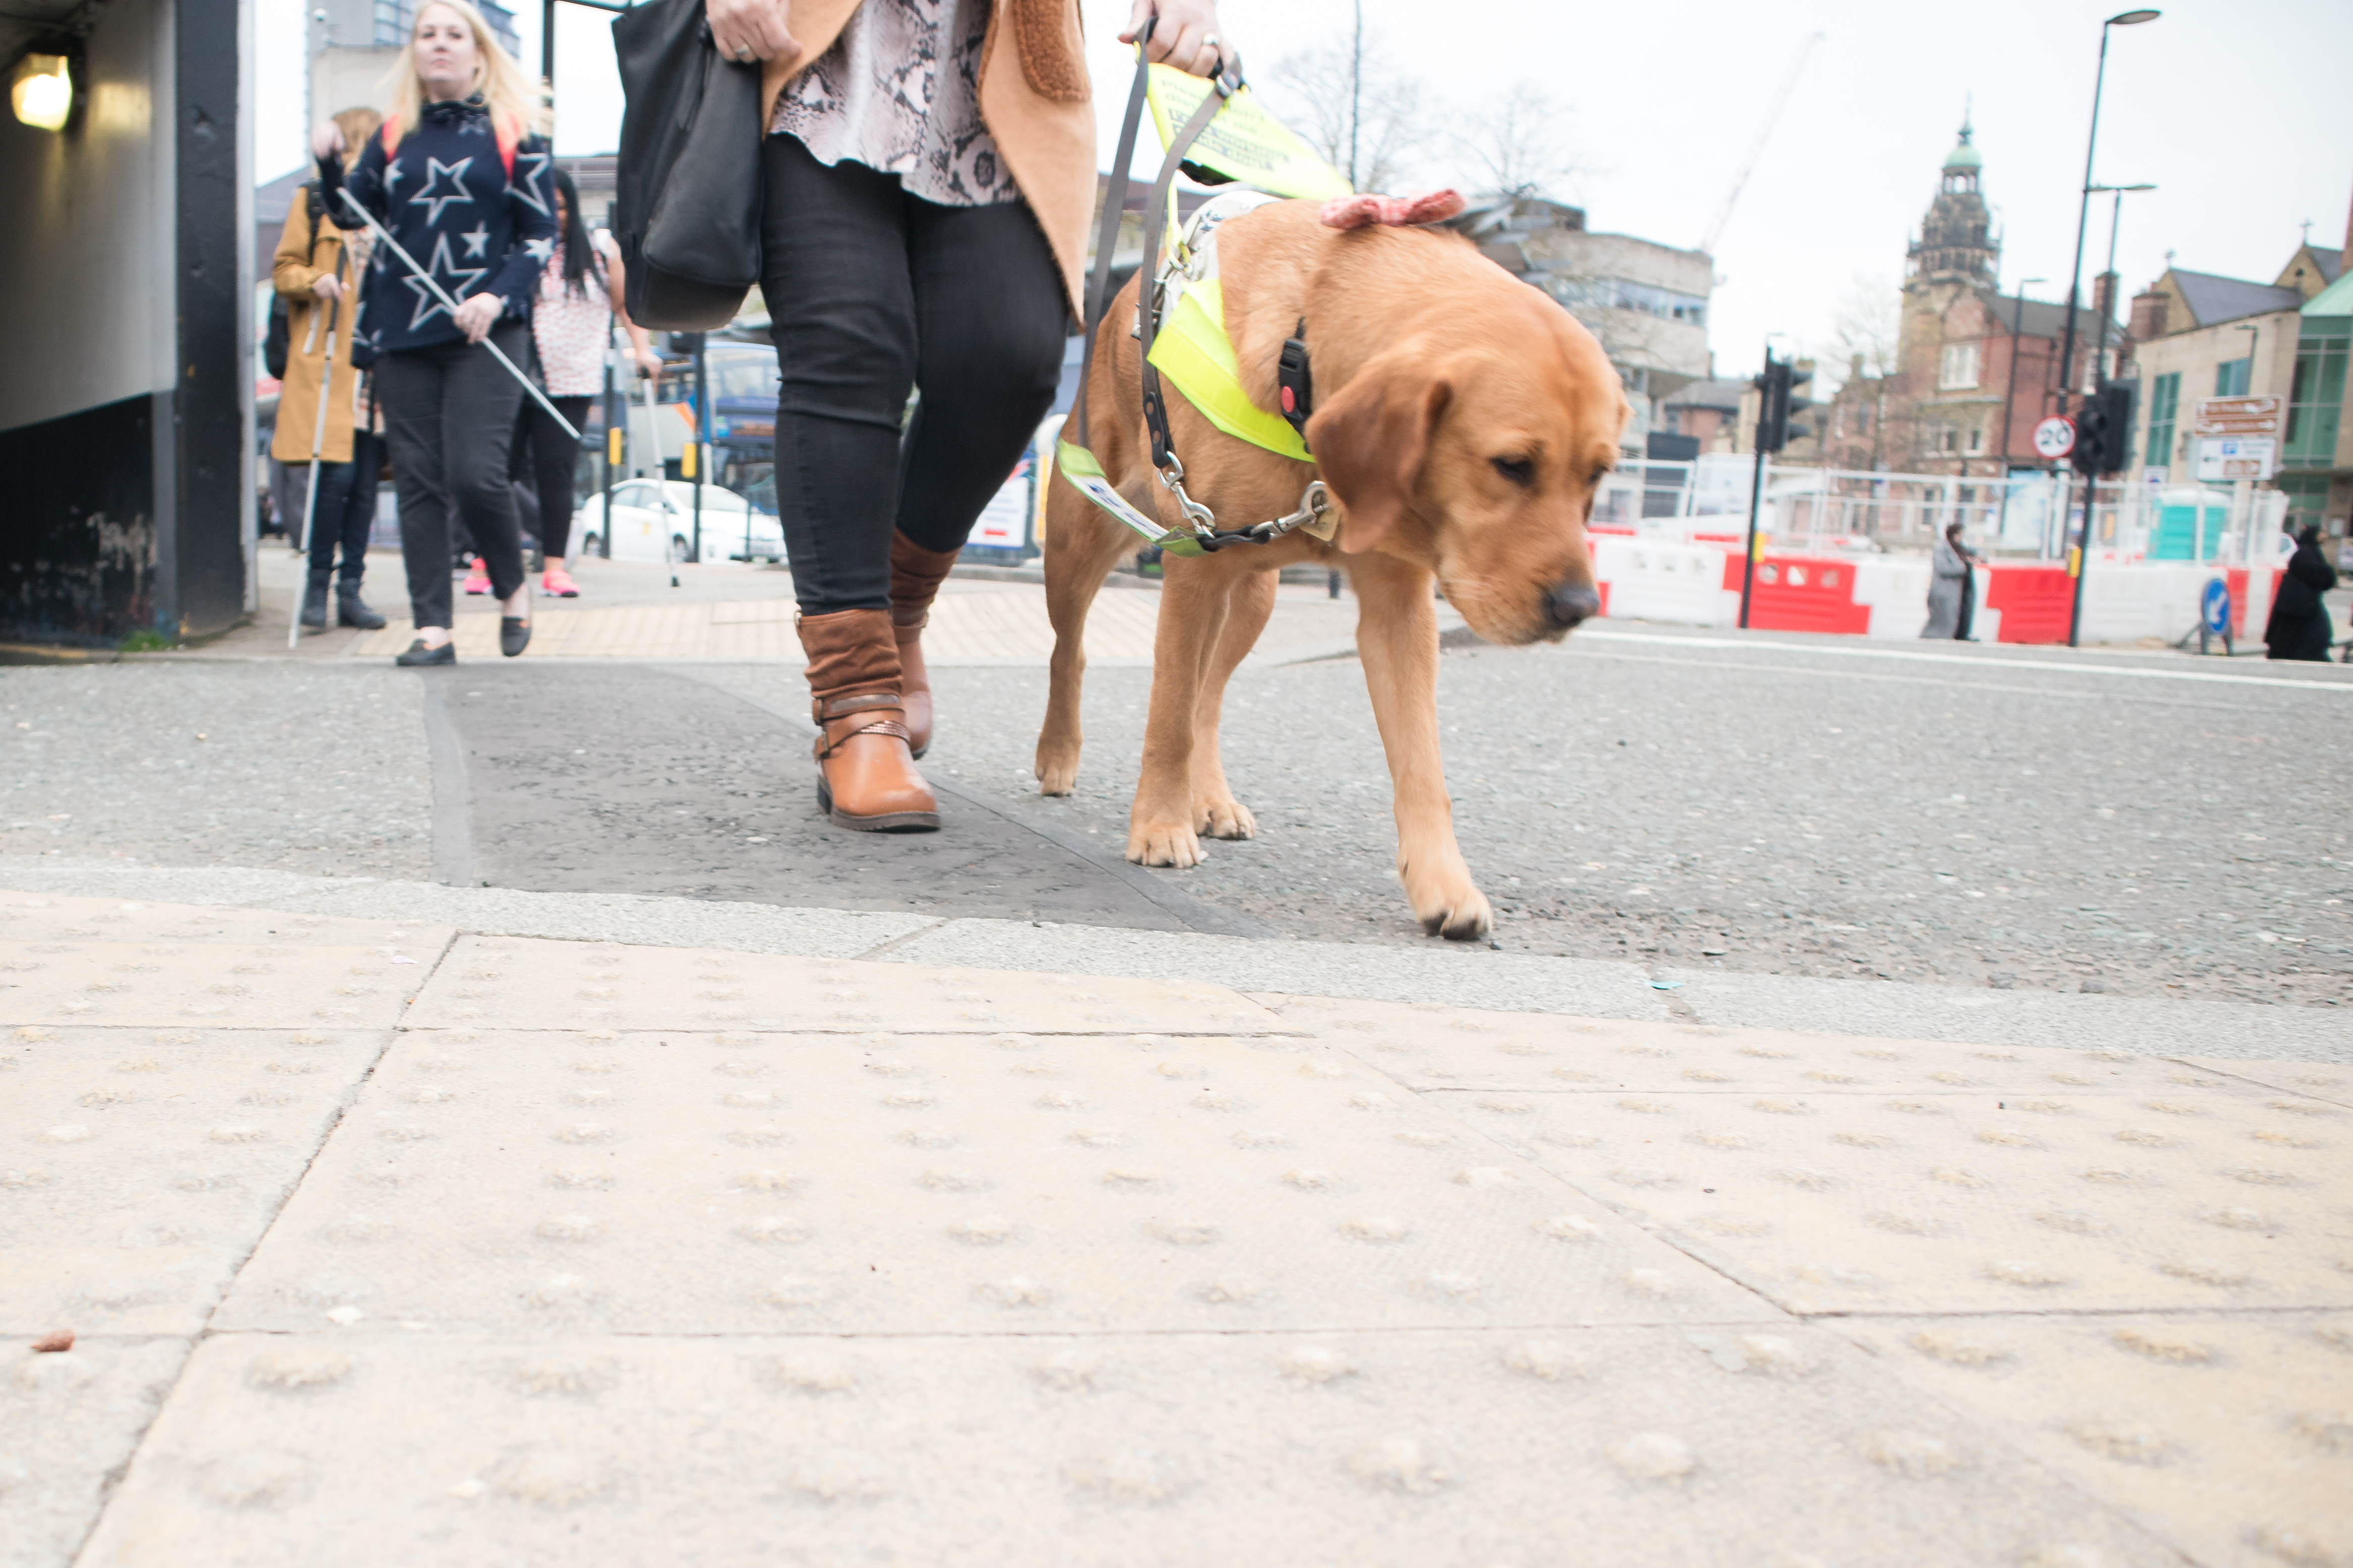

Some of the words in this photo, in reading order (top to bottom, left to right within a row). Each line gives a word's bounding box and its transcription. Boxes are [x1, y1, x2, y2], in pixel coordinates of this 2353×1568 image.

[1161, 79, 1206, 101] Pleas
[1233, 122, 1258, 134] me
[1216, 129, 1284, 161] working
[2040, 426, 2069, 445] 20
